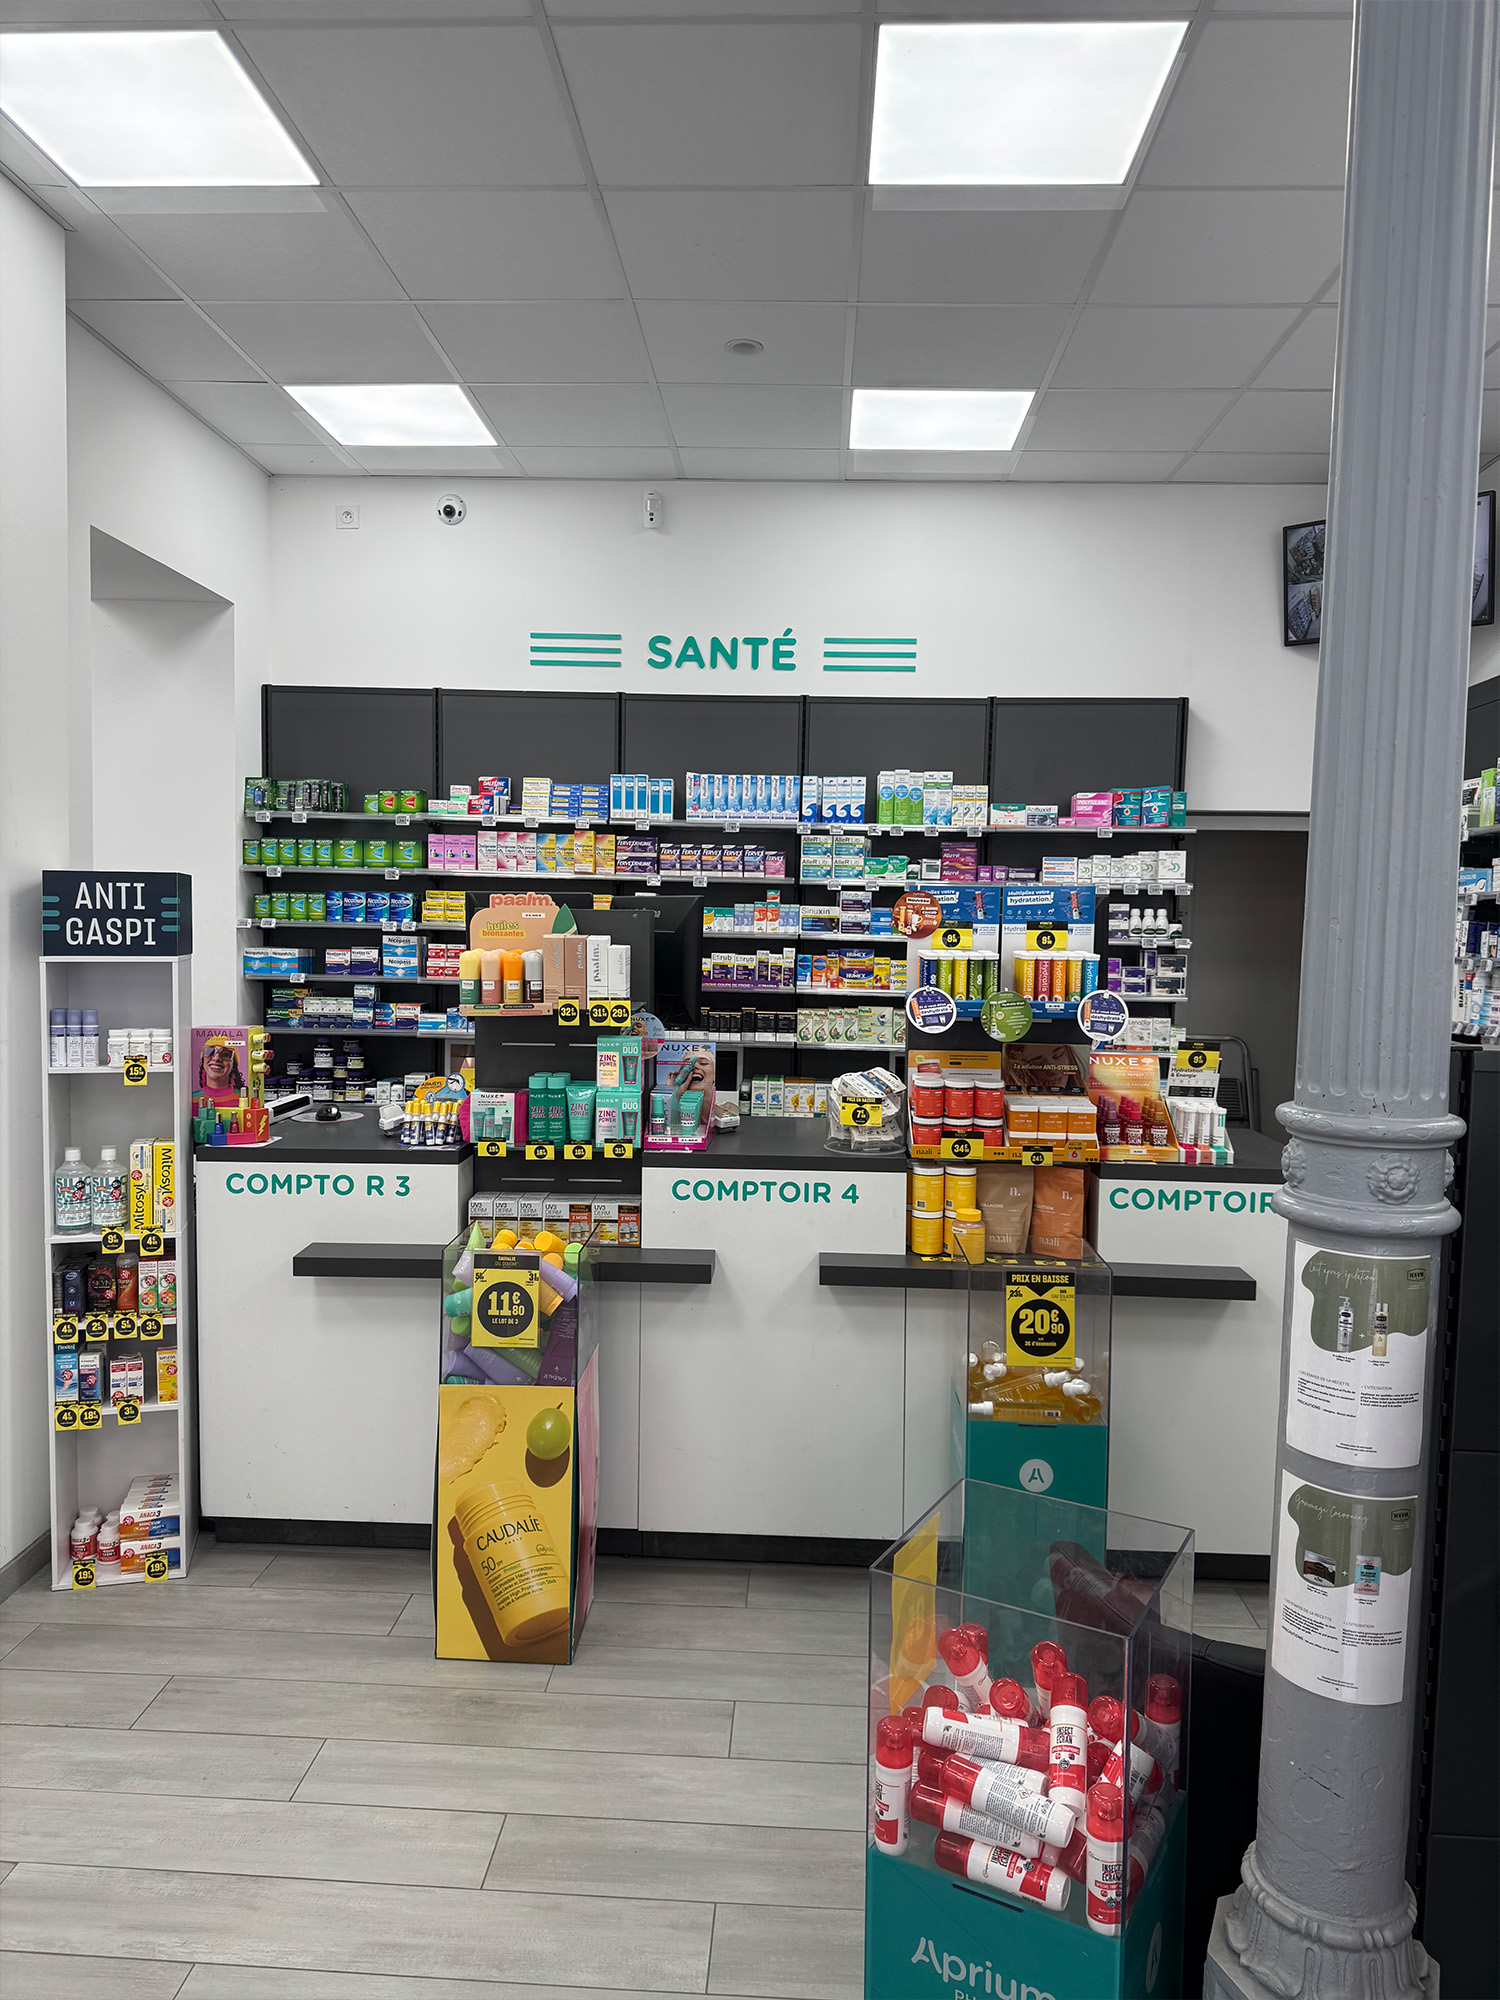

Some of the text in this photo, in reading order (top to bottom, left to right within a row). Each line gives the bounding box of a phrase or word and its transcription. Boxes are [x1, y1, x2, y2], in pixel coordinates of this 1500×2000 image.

[647, 627, 798, 671] SANTÉ
[74, 882, 146, 909] ANTI
[490, 893, 554, 908] paalm.
[801, 907, 831, 916] Sinuxin
[65, 917, 157, 946] GASPI
[487, 921, 519, 930] huiles
[482, 930, 525, 938] bronzantes
[196, 1029, 244, 1039] MAVALA
[1090, 1056, 1139, 1066] NUXE
[161, 1148, 173, 1195] Mitosyl
[367, 1175, 385, 1197] R
[395, 1175, 411, 1197] 3
[672, 1179, 860, 1204] COMPTOIR 4
[1009, 1187, 1021, 1197] n.
[1062, 1190, 1073, 1201] n.
[1109, 1187, 1276, 1214] COMPTOIR
[134, 1182, 147, 1231] Mitosyl
[989, 1234, 1013, 1244] naali
[1039, 1236, 1060, 1247] naali
[1012, 1275, 1069, 1284] PRIX EN BAISSE
[481, 1557, 496, 1577] 50
[515, 1570, 530, 1579] Haute
[530, 1565, 553, 1574] Protection
[521, 1581, 546, 1592] Protection
[1056, 1726, 1074, 1735] INSECT
[911, 1936, 1057, 2000] Aprium
